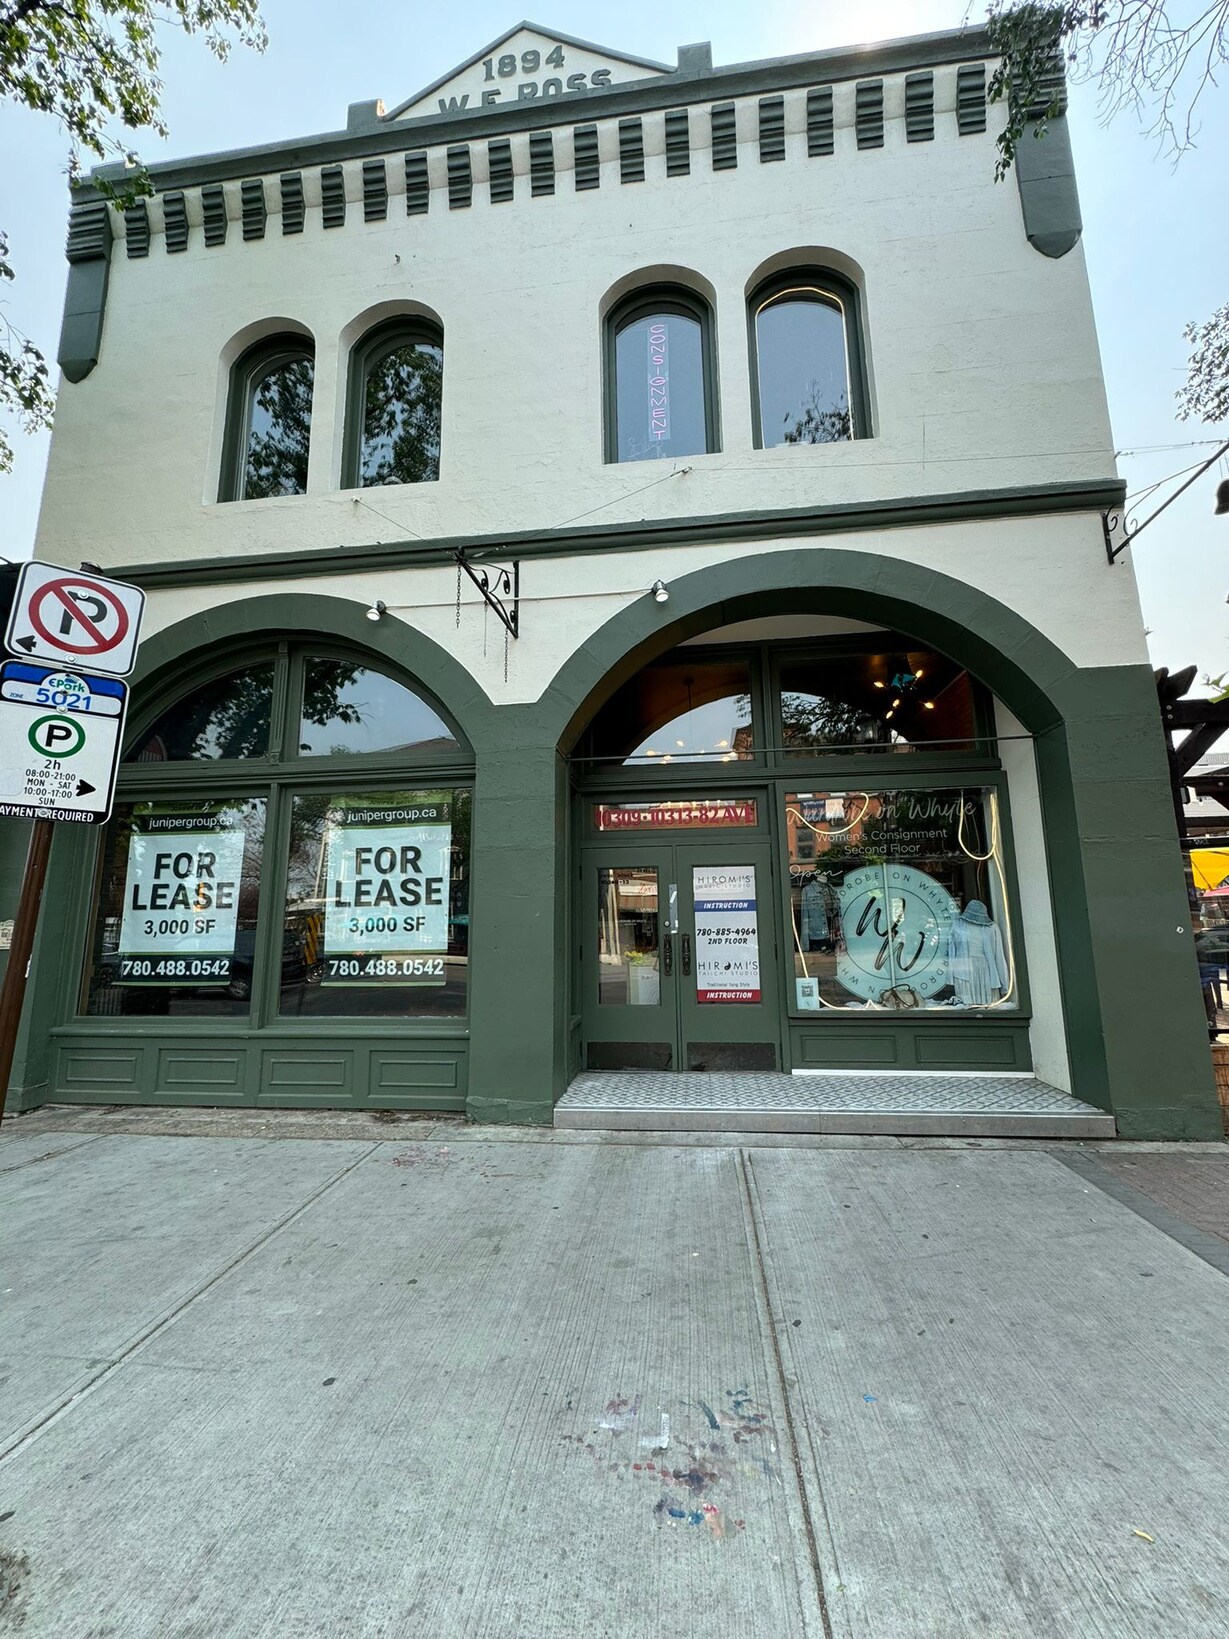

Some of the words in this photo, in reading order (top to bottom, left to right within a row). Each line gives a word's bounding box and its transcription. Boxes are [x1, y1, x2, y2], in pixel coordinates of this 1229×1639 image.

[483, 45, 565, 81] 1894
[650, 324, 666, 440] CONSIGNMENT
[36, 688, 92, 710] 5021
[44, 759, 61, 770] 2h
[27, 778, 45, 787] MON
[58, 782, 72, 790] SAT
[38, 797, 56, 805] SUN
[909, 797, 976, 823] Whyte
[149, 815, 233, 830] junipergroup.ca
[347, 808, 436, 823] junipergroup.ca
[816, 831, 867, 842] Women's
[871, 828, 948, 842] Consignment
[844, 843, 886, 855] Second
[891, 842, 921, 854] Floor
[153, 852, 216, 879] FOR
[355, 845, 422, 876] FOR
[789, 864, 844, 886] Open
[892, 872, 911, 882] ON
[131, 882, 235, 911] LEASE
[335, 877, 443, 908] LEASE
[144, 920, 189, 938] 3,000
[194, 919, 216, 934] SF
[349, 917, 397, 937] 3,000
[403, 916, 426, 932] SF
[697, 928, 756, 936] 780-885-4964
[122, 960, 230, 976] 780.488.0542
[329, 959, 444, 976] 780.488.0542
